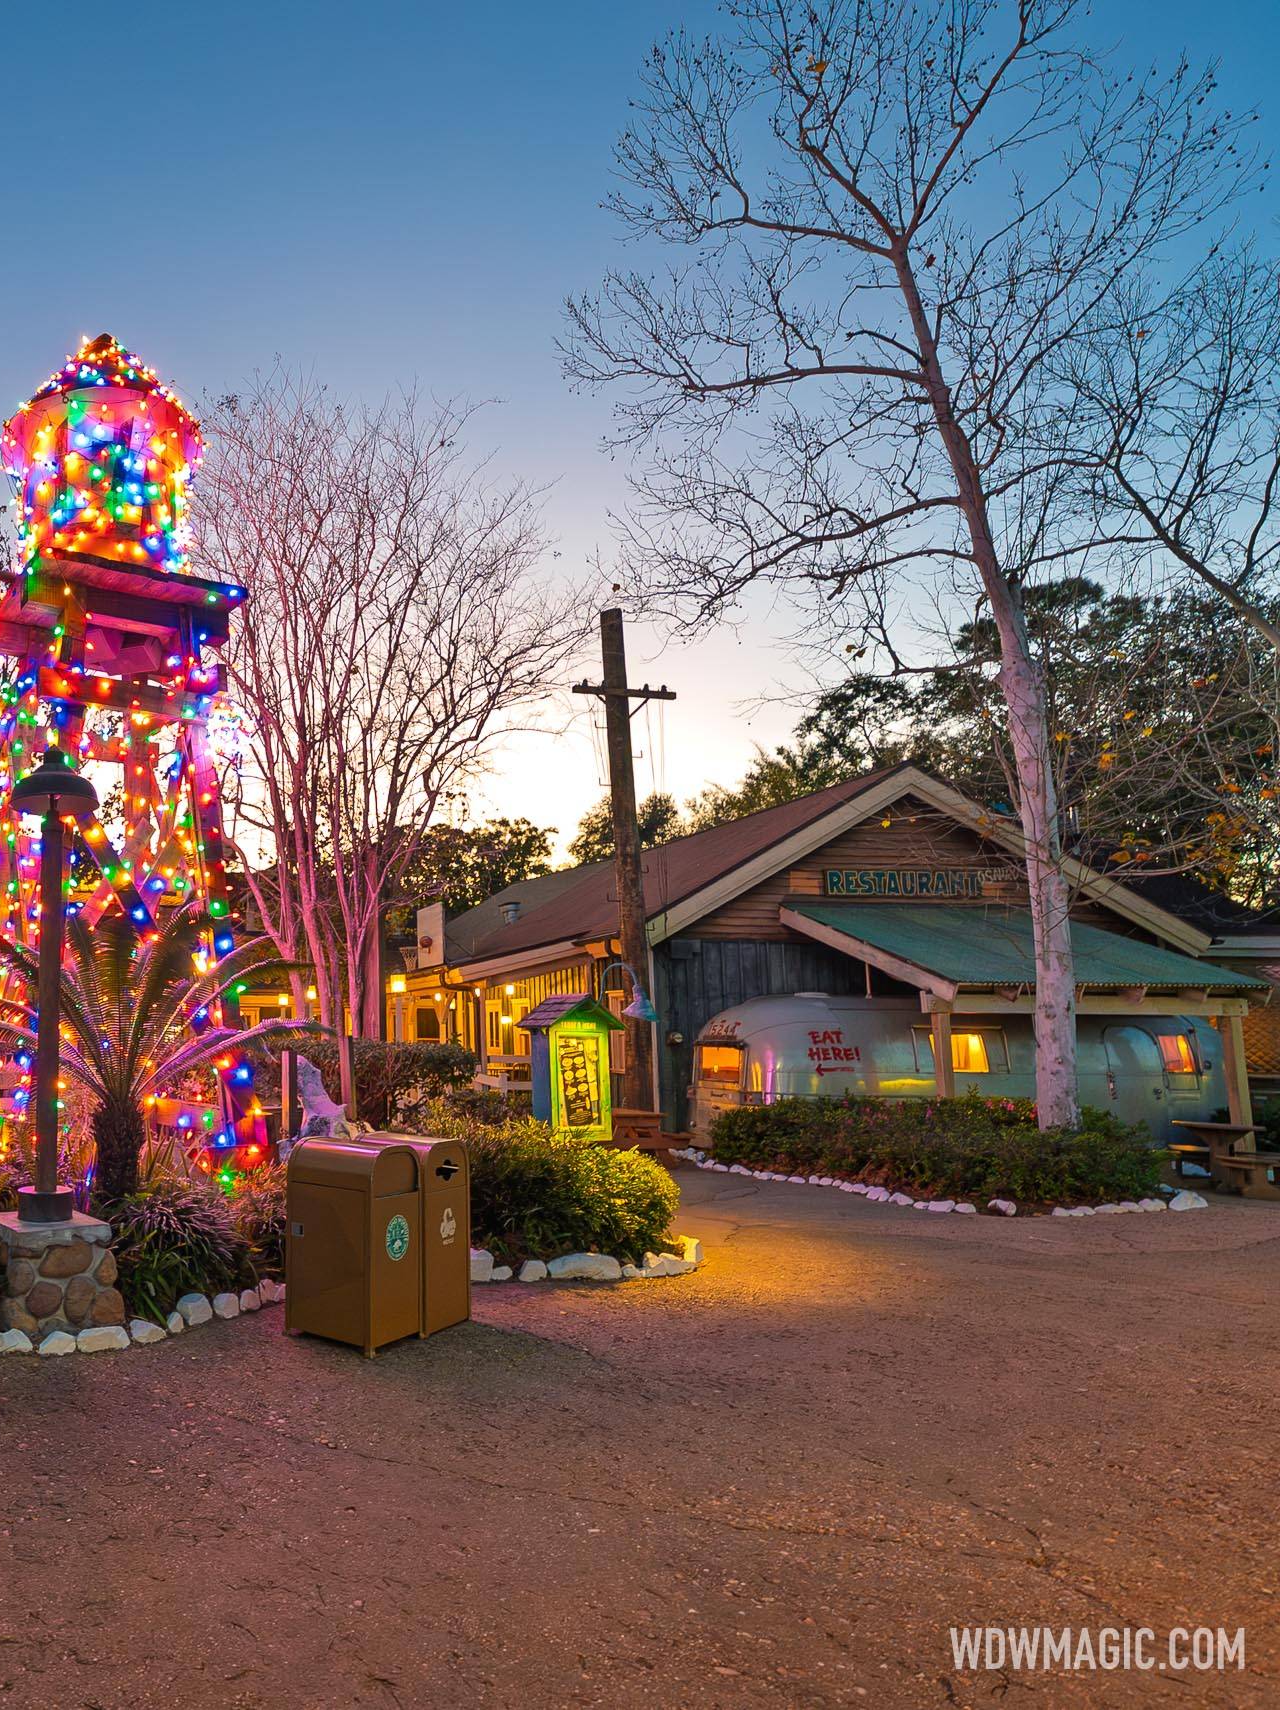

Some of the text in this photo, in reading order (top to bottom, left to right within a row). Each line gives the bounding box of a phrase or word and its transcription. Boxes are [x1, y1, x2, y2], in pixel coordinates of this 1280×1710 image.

[827, 870, 979, 897] RESTAURANT
[808, 1029, 844, 1045] EAT
[808, 1046, 861, 1061] HERE!
